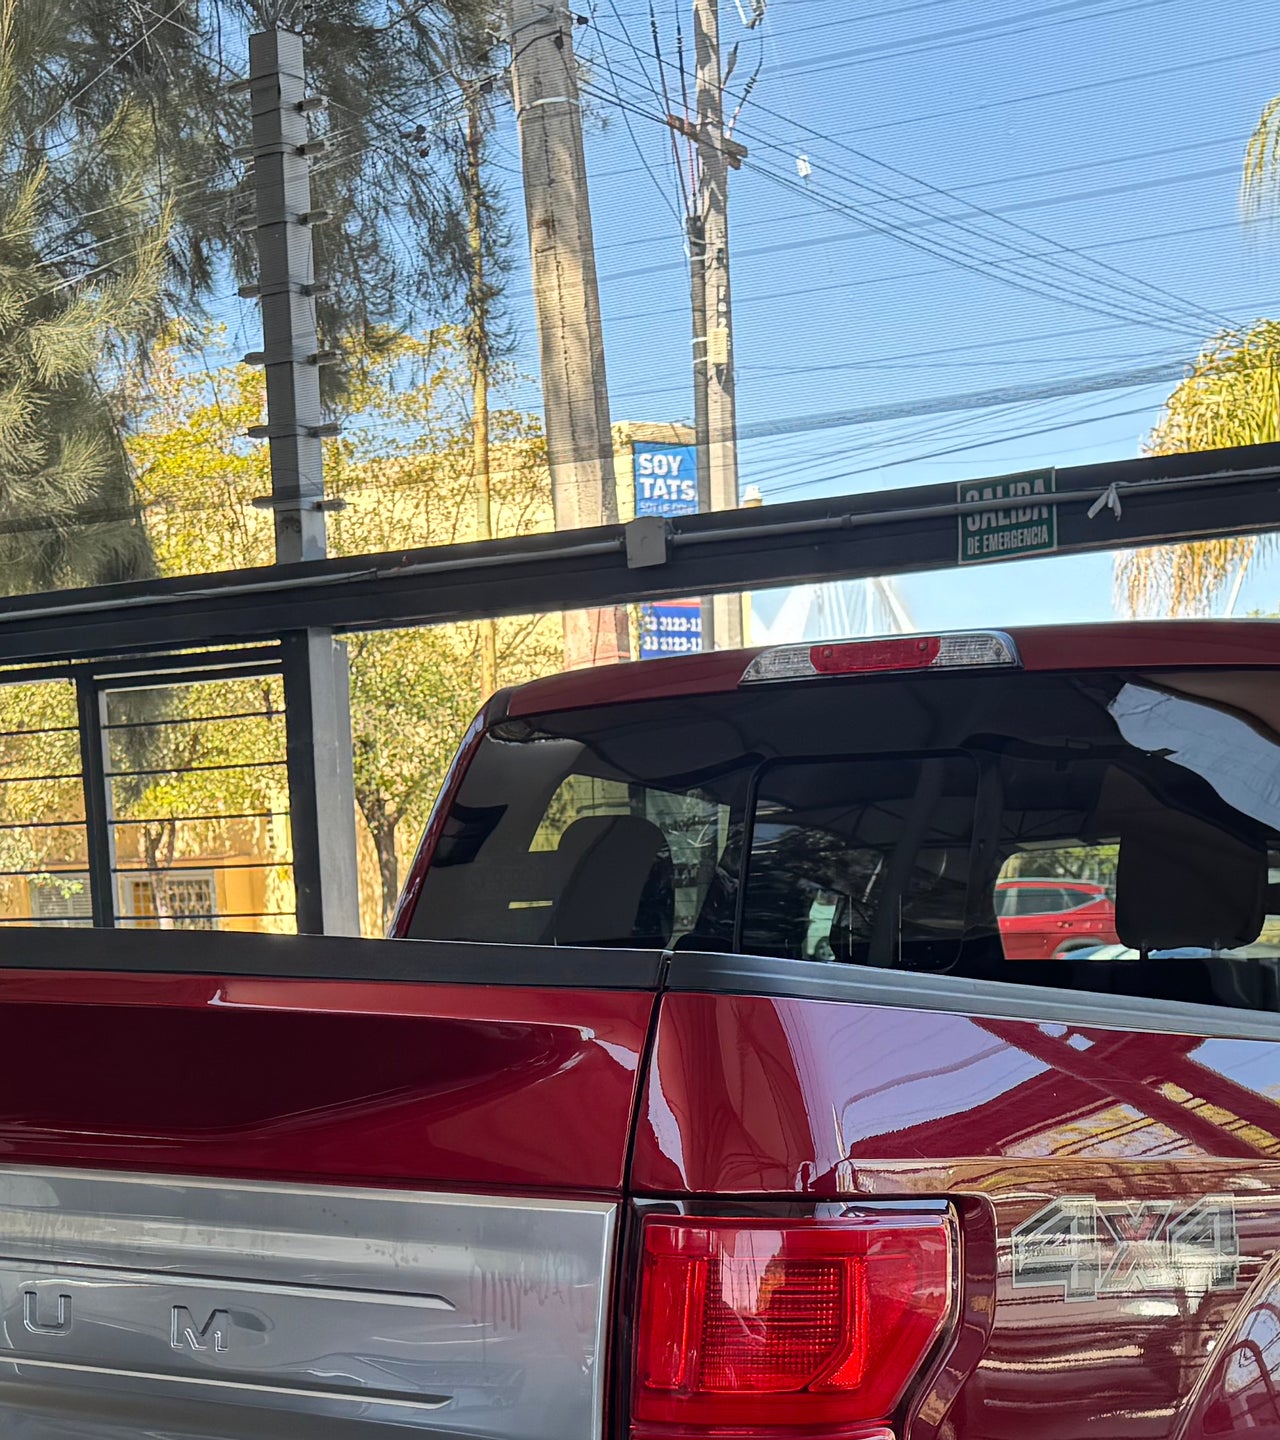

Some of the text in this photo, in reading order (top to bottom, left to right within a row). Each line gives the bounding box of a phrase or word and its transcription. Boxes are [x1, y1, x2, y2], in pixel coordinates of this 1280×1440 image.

[639, 453, 682, 476] SOY
[639, 478, 695, 501] TATS
[965, 479, 1049, 531] SALIDA
[967, 525, 1048, 555] DE EMERGENCIA
